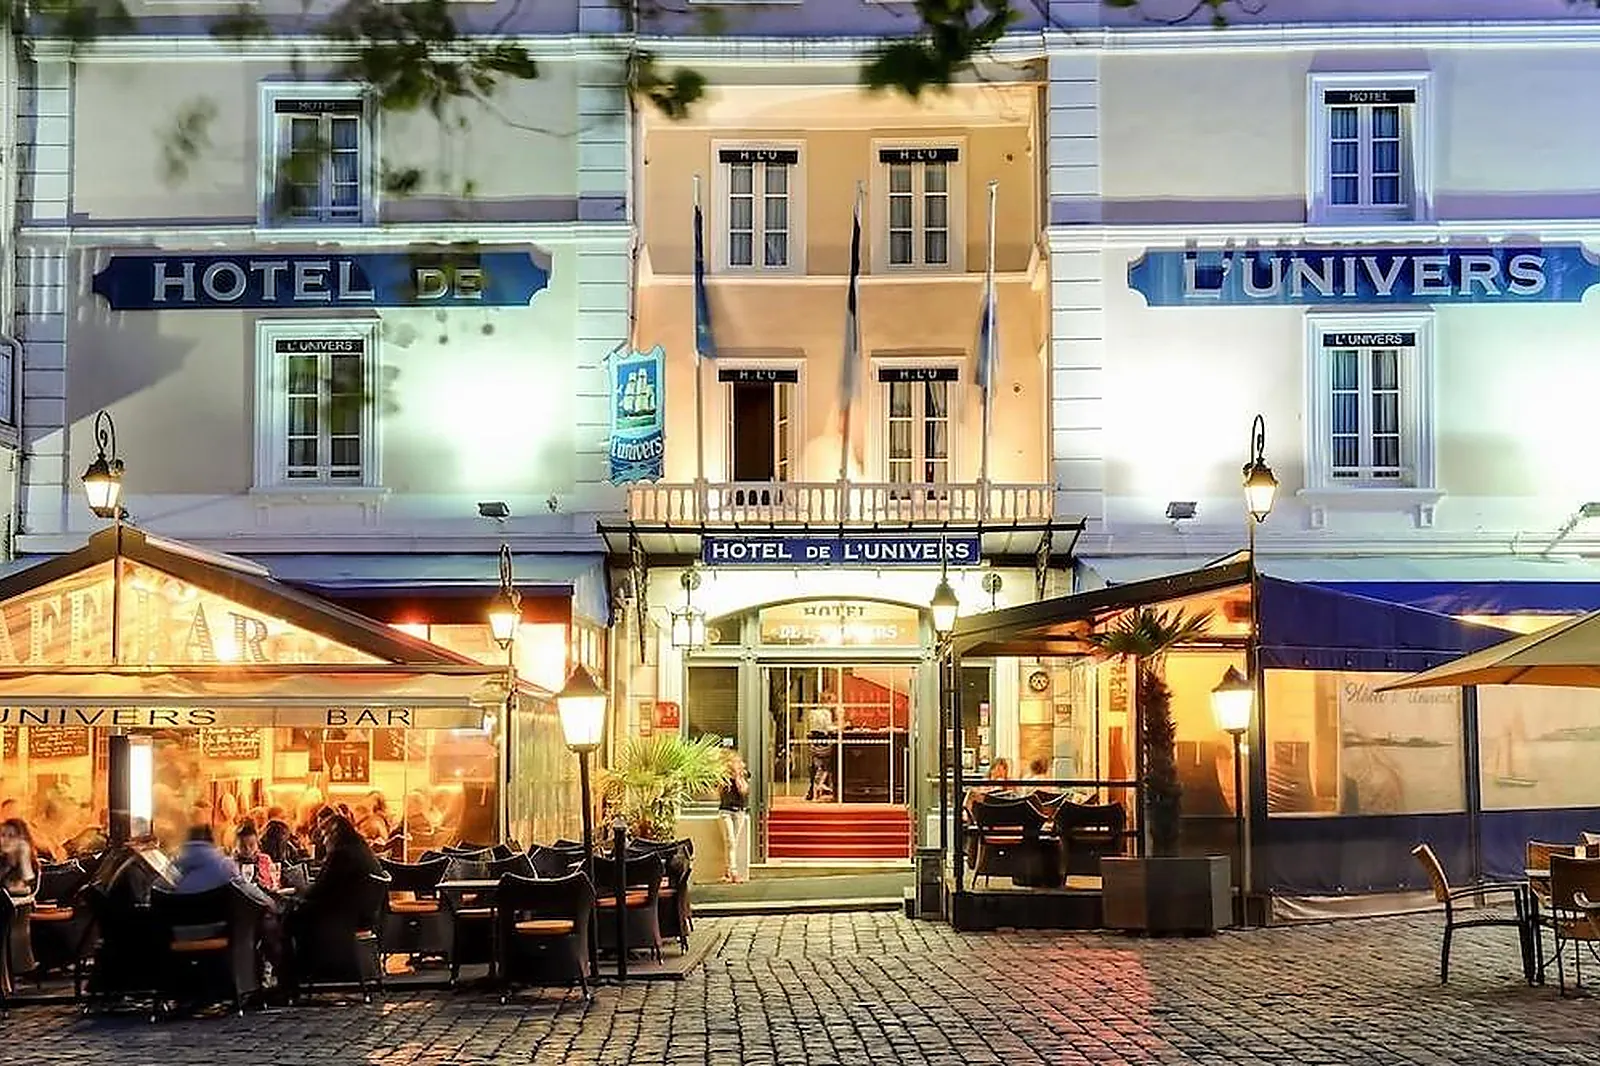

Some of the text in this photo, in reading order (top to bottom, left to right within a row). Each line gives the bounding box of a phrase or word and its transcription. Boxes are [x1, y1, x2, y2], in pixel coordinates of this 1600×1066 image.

[1348, 92, 1390, 102] HOTEL
[153, 261, 483, 302] HOTEL DE
[1184, 254, 1549, 299] L'UNIVERS
[712, 543, 970, 560] HOTEL DE L'UNIVERS
[327, 708, 410, 726] BAR
